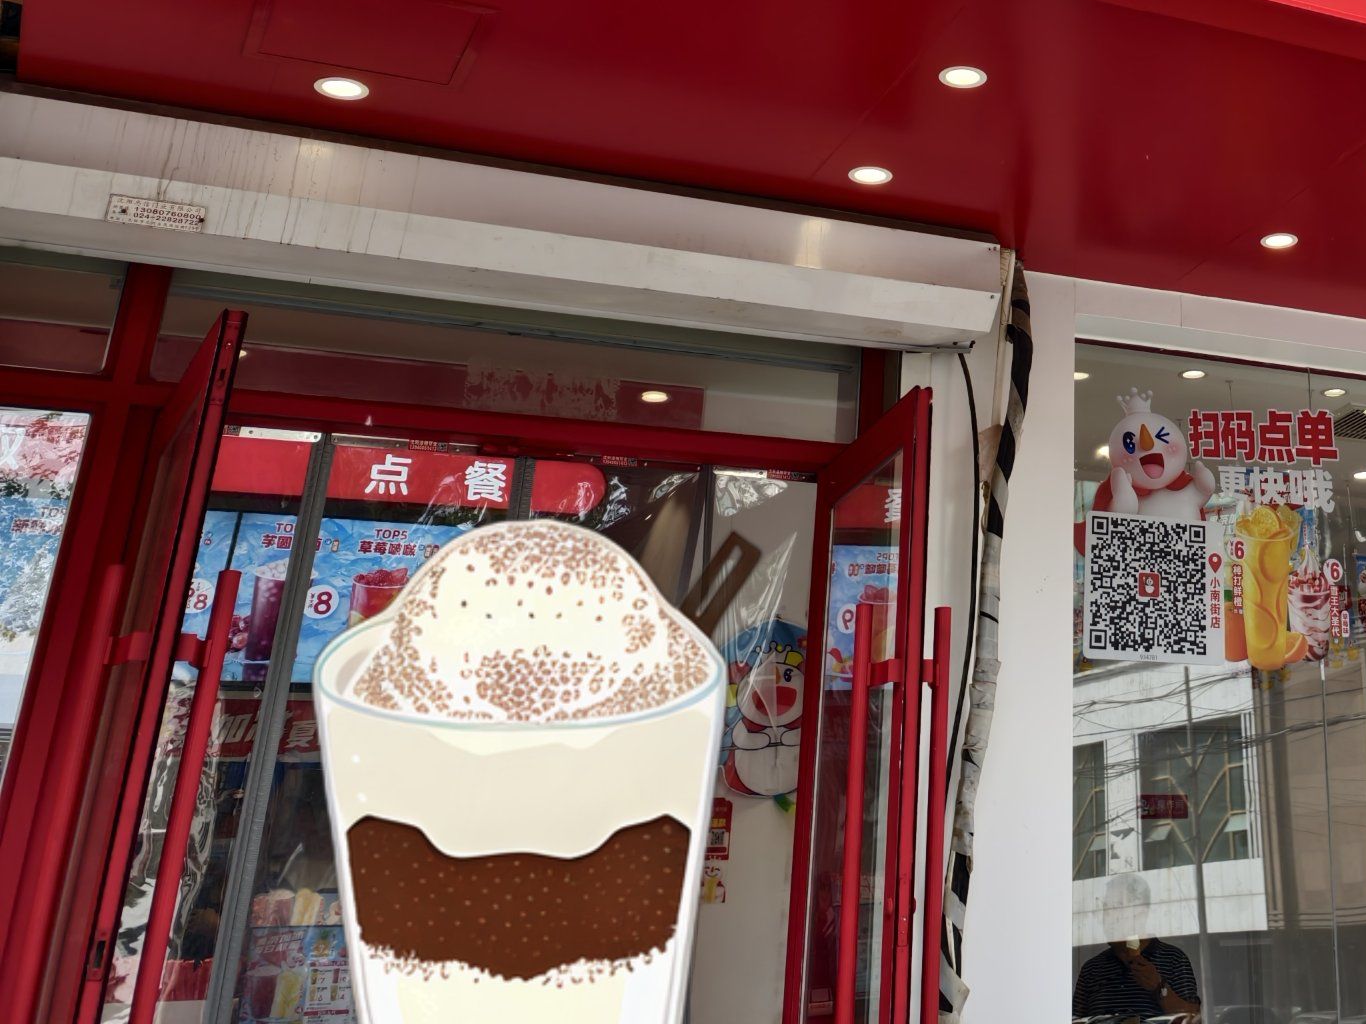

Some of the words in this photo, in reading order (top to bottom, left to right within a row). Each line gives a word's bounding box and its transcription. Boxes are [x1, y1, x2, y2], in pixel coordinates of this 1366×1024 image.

[1188, 410, 1339, 466] 扫码点单
[365, 454, 507, 503] 点餐
[375, 529, 408, 540] TOP5
[1209, 577, 1221, 629] 小南街店
